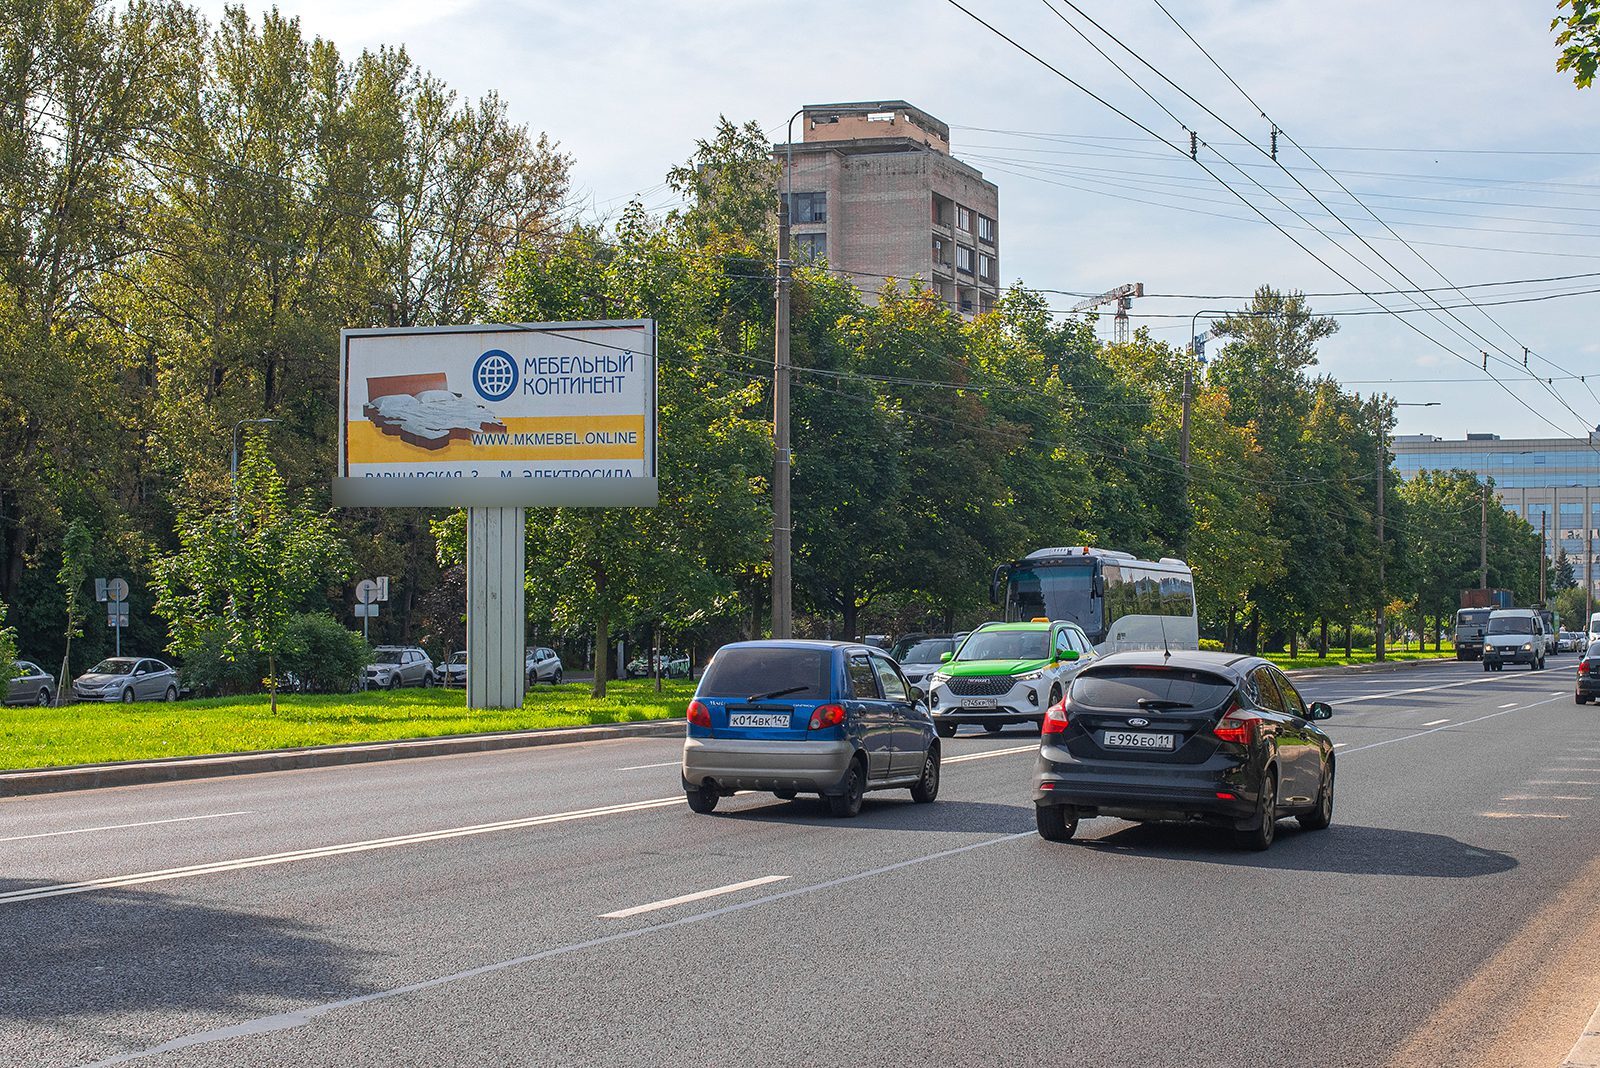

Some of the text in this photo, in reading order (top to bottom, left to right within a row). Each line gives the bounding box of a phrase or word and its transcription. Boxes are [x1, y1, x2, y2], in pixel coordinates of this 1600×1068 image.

[524, 350, 634, 375] МЕБЕЛЬНЫЙ
[523, 375, 626, 395] КОНТИНЕНТ
[471, 431, 637, 446] WWW.MKMEBEL.ONLINE
[772, 715, 787, 725] 147
[1158, 735, 1169, 745] 11
